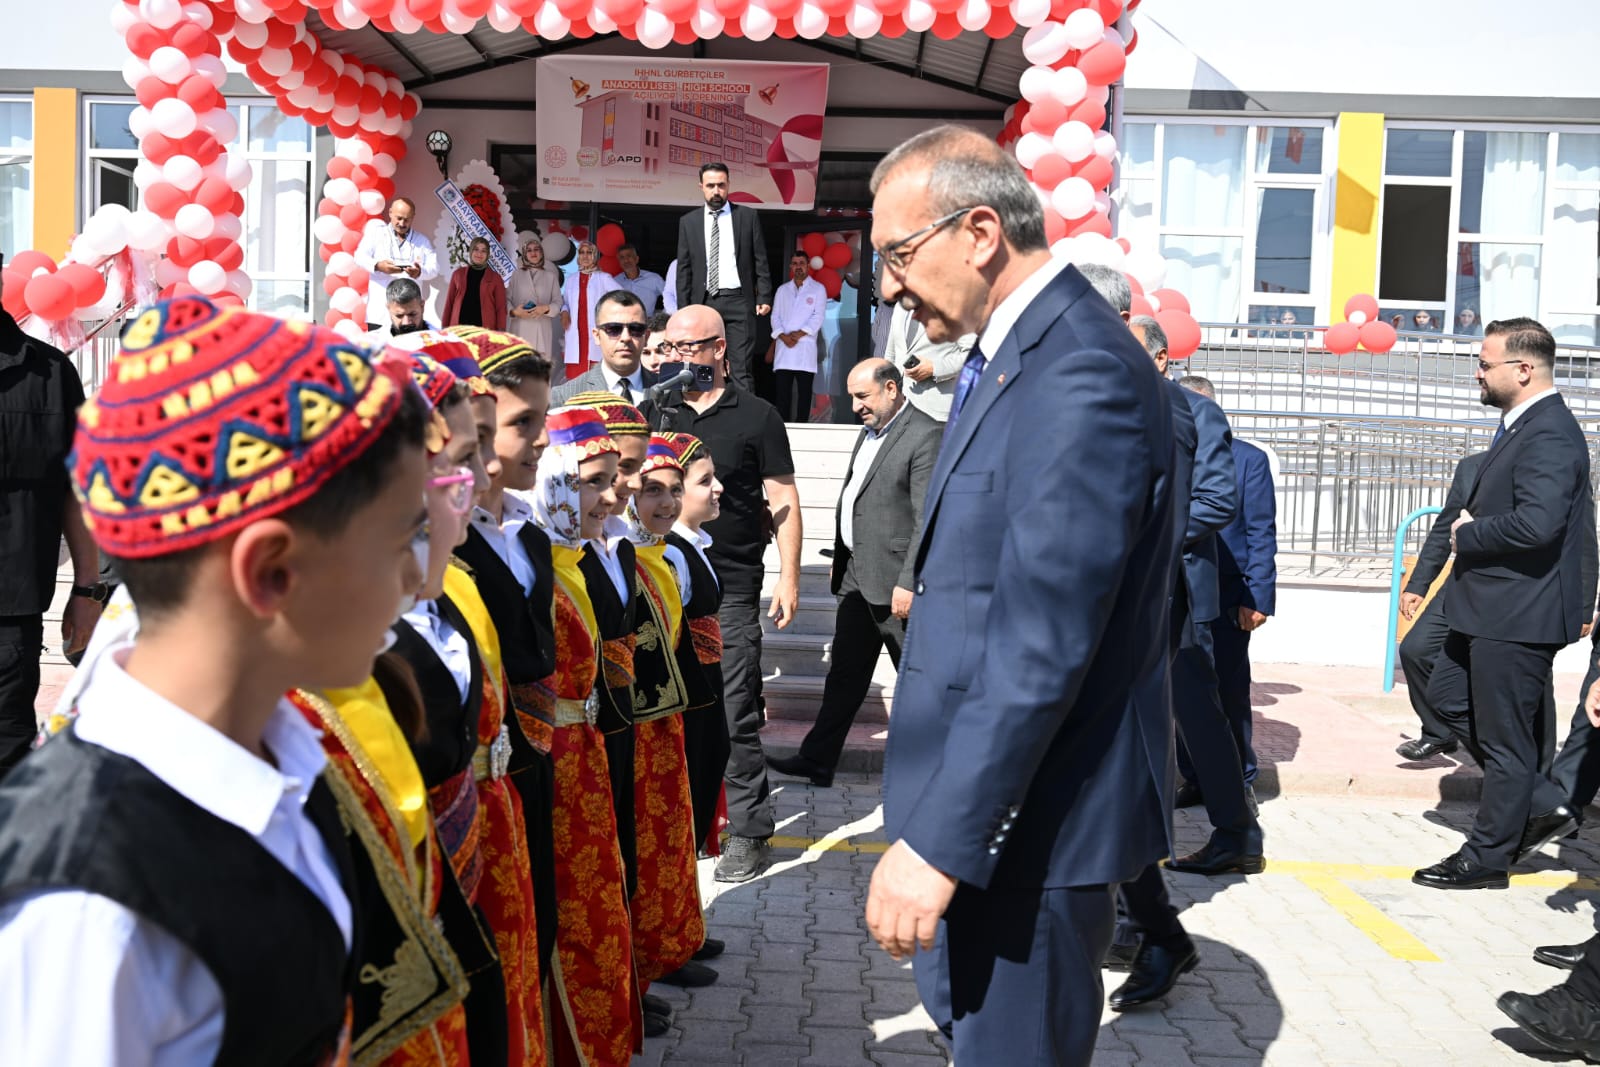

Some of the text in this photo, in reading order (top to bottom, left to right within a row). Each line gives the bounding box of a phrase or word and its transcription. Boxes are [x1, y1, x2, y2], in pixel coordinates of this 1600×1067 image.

[663, 69, 725, 80] GURBETÇİLER
[603, 80, 648, 90] ANADOLU
[683, 84, 749, 93] HIGH SCHOOL
[633, 91, 675, 101] AÇILIYOR
[682, 93, 733, 102] IS OPENING
[616, 155, 642, 163] APD
[456, 200, 487, 238] BAYRAM
